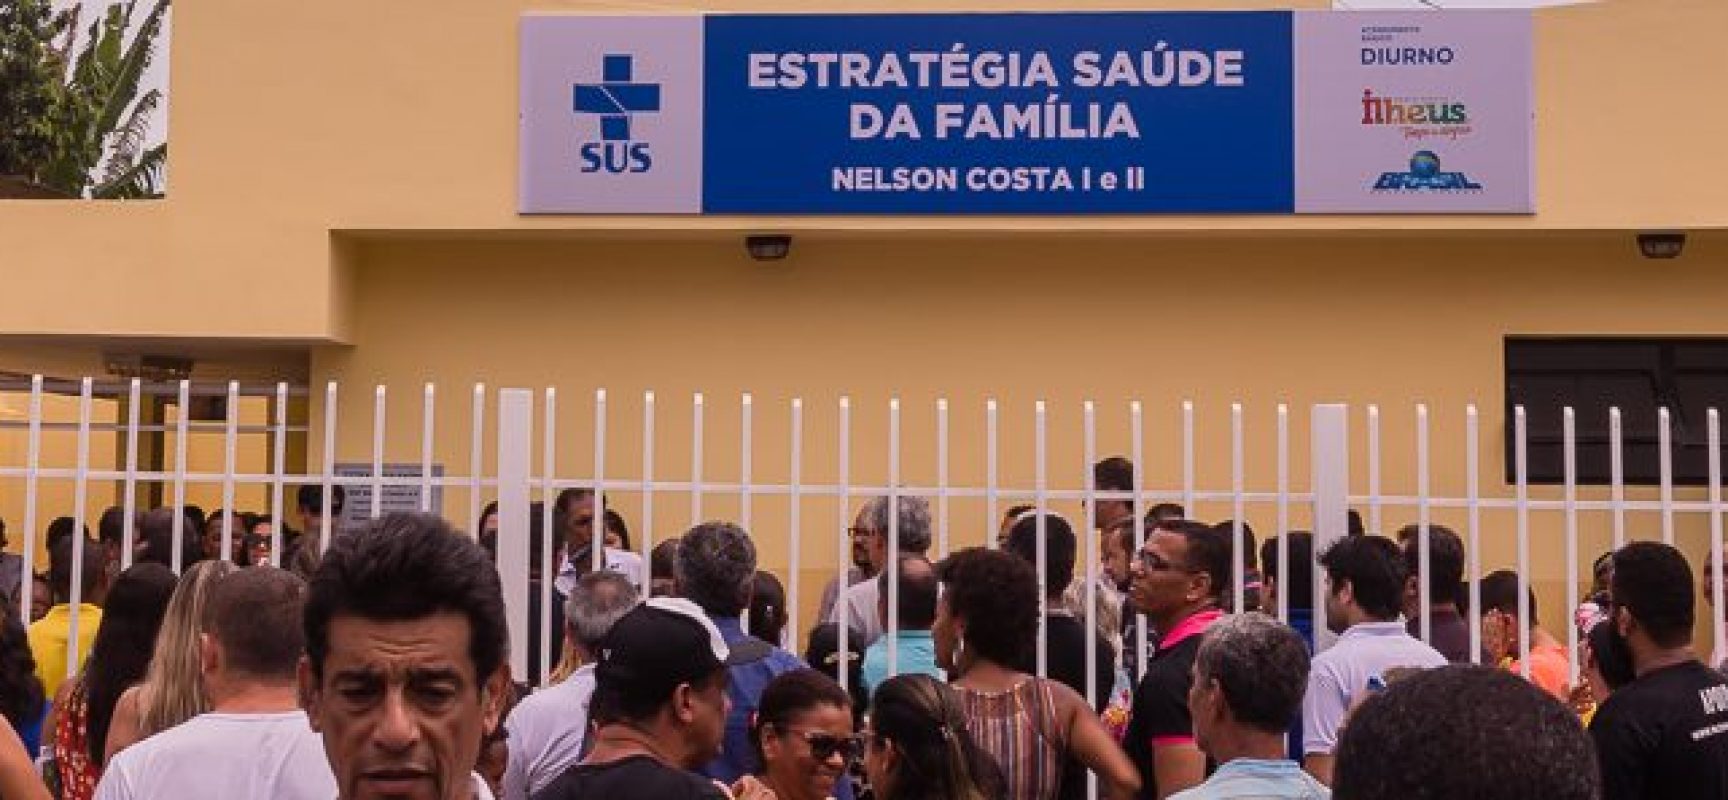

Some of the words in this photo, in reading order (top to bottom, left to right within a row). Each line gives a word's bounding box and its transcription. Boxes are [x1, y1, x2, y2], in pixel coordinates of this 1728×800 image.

[748, 43, 1059, 88] ESTRATÉGIA
[1073, 41, 1244, 88] SAÚDE
[1361, 47, 1454, 66] DIURNO
[850, 104, 921, 139] DA
[936, 94, 1139, 139] FAMÍLIA
[580, 143, 653, 174] SUS
[832, 167, 957, 191] NELSON
[965, 167, 1074, 191] COSTA
[1083, 167, 1091, 190] I
[1100, 172, 1118, 190] e
[1127, 167, 1145, 190] II
